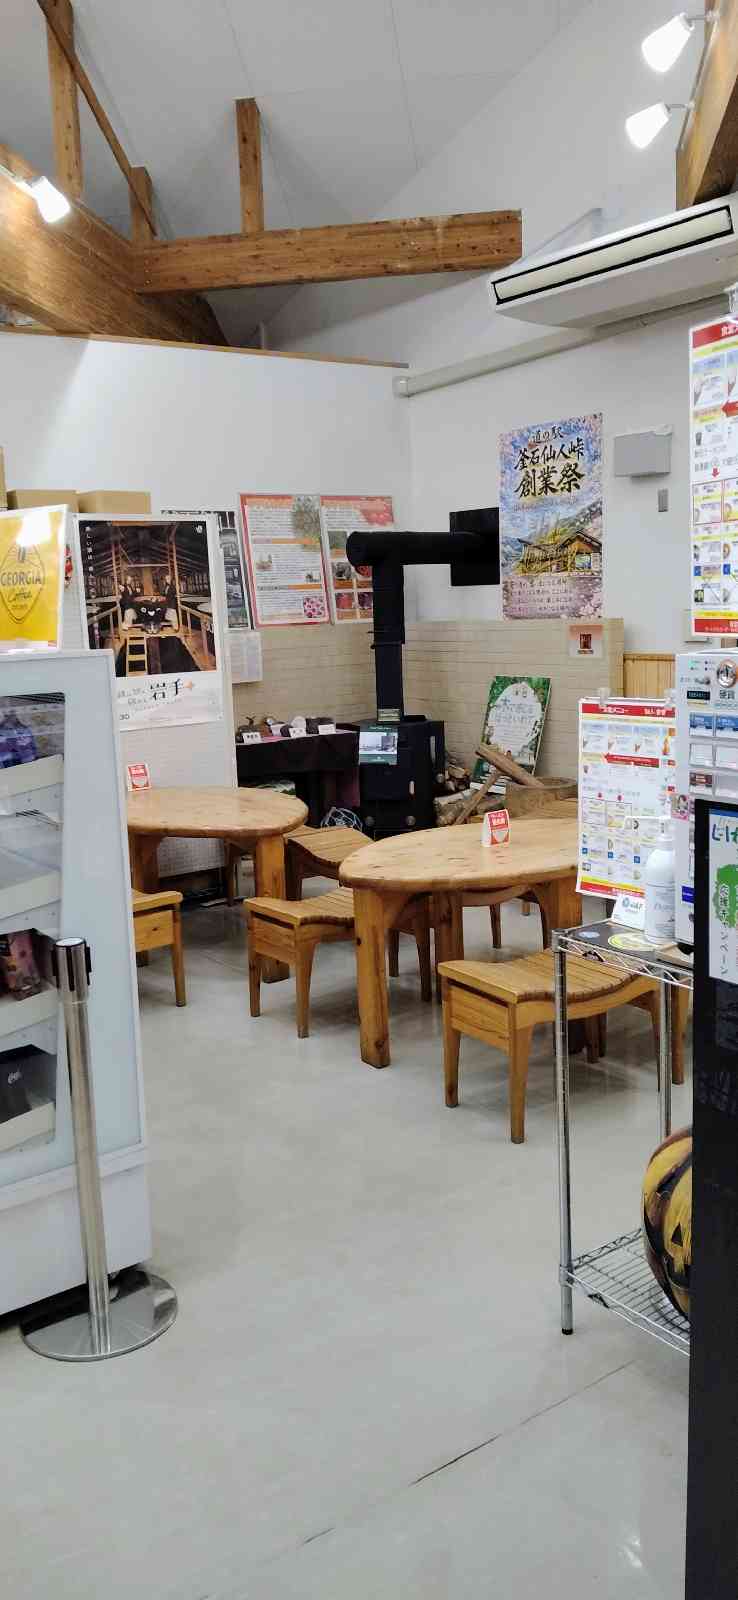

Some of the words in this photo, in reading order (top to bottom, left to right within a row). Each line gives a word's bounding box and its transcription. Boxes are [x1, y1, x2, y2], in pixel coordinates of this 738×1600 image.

[532, 426, 564, 444] 道の駅
[513, 437, 585, 470] 釜石仙人峠
[513, 462, 585, 498] 創業祭
[1, 571, 42, 587] GEORGIA
